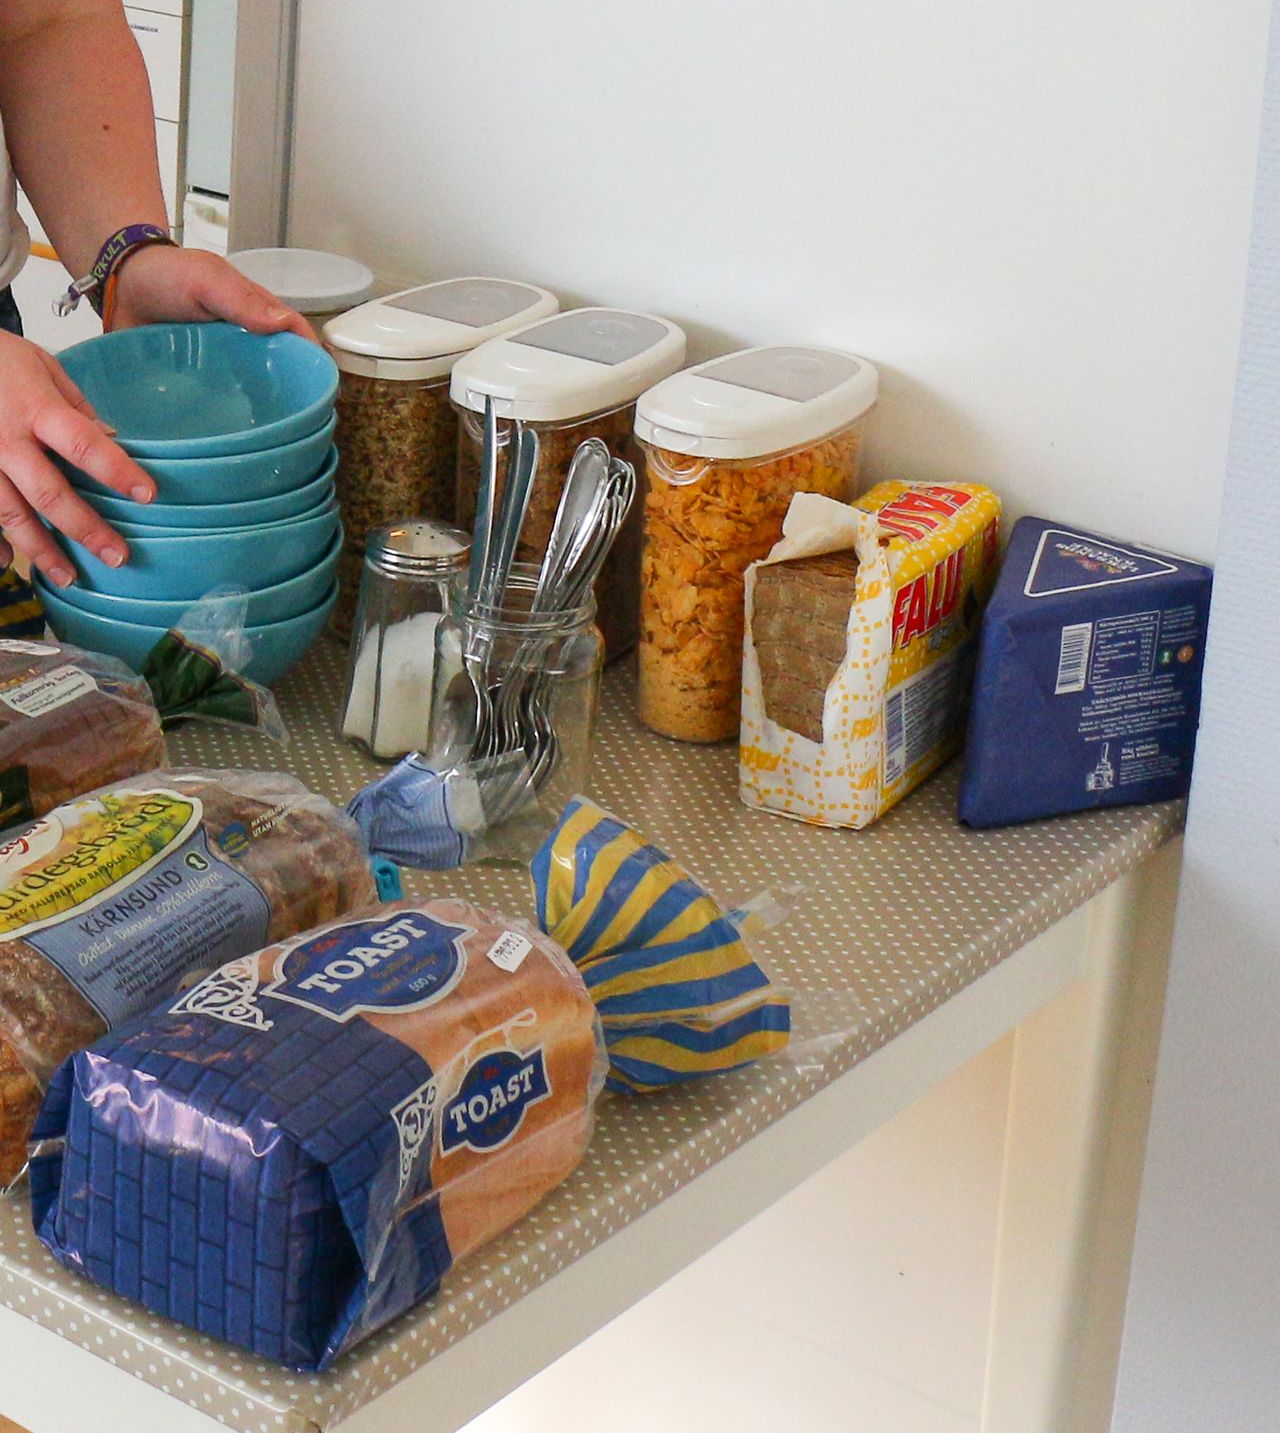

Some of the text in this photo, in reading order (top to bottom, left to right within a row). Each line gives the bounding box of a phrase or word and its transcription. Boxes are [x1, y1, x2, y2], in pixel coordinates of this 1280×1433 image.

[892, 546, 965, 654] FALU
[78, 868, 183, 937] KÄRNSUND
[296, 919, 427, 994] TOAST
[450, 1064, 534, 1133] TOAST
